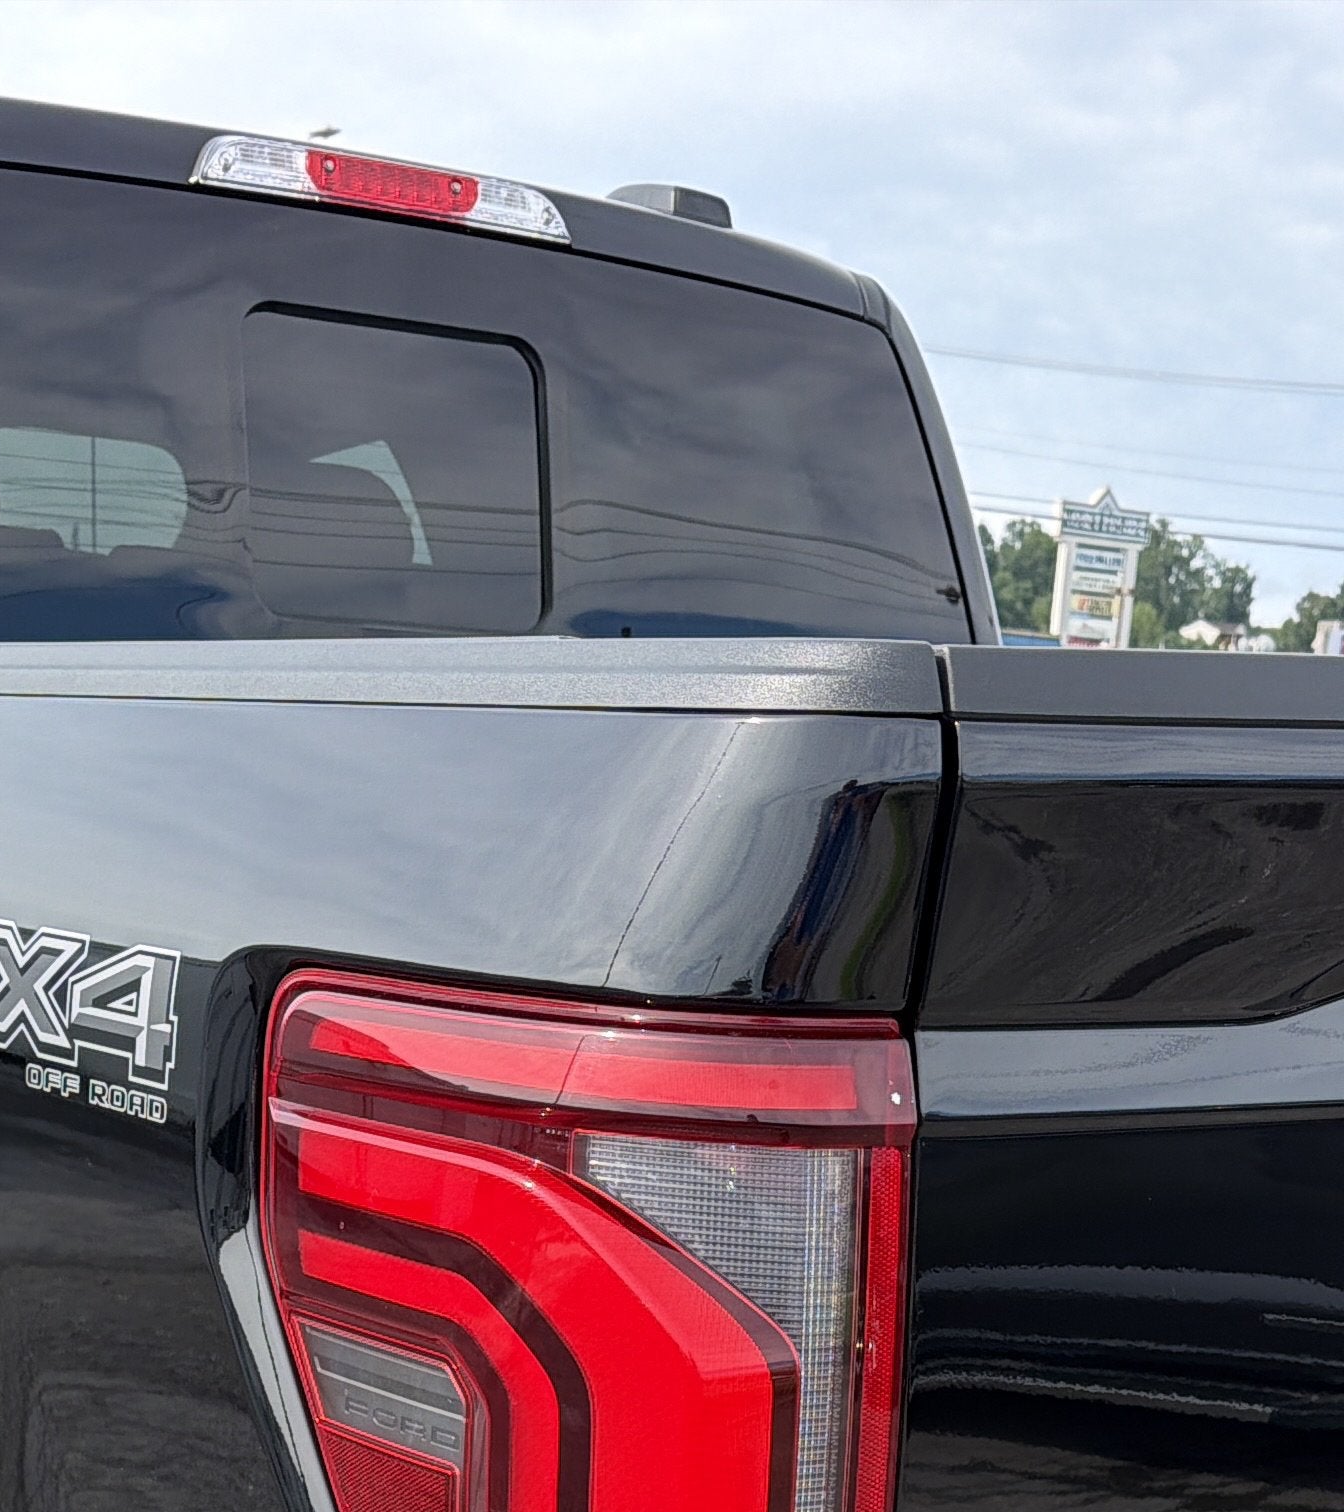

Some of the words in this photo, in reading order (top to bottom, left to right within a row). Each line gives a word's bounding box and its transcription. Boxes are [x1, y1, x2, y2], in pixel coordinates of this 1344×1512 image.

[25, 1063, 80, 1099] OFF
[88, 1080, 168, 1123] ROAD
[343, 1395, 460, 1452] FORD
